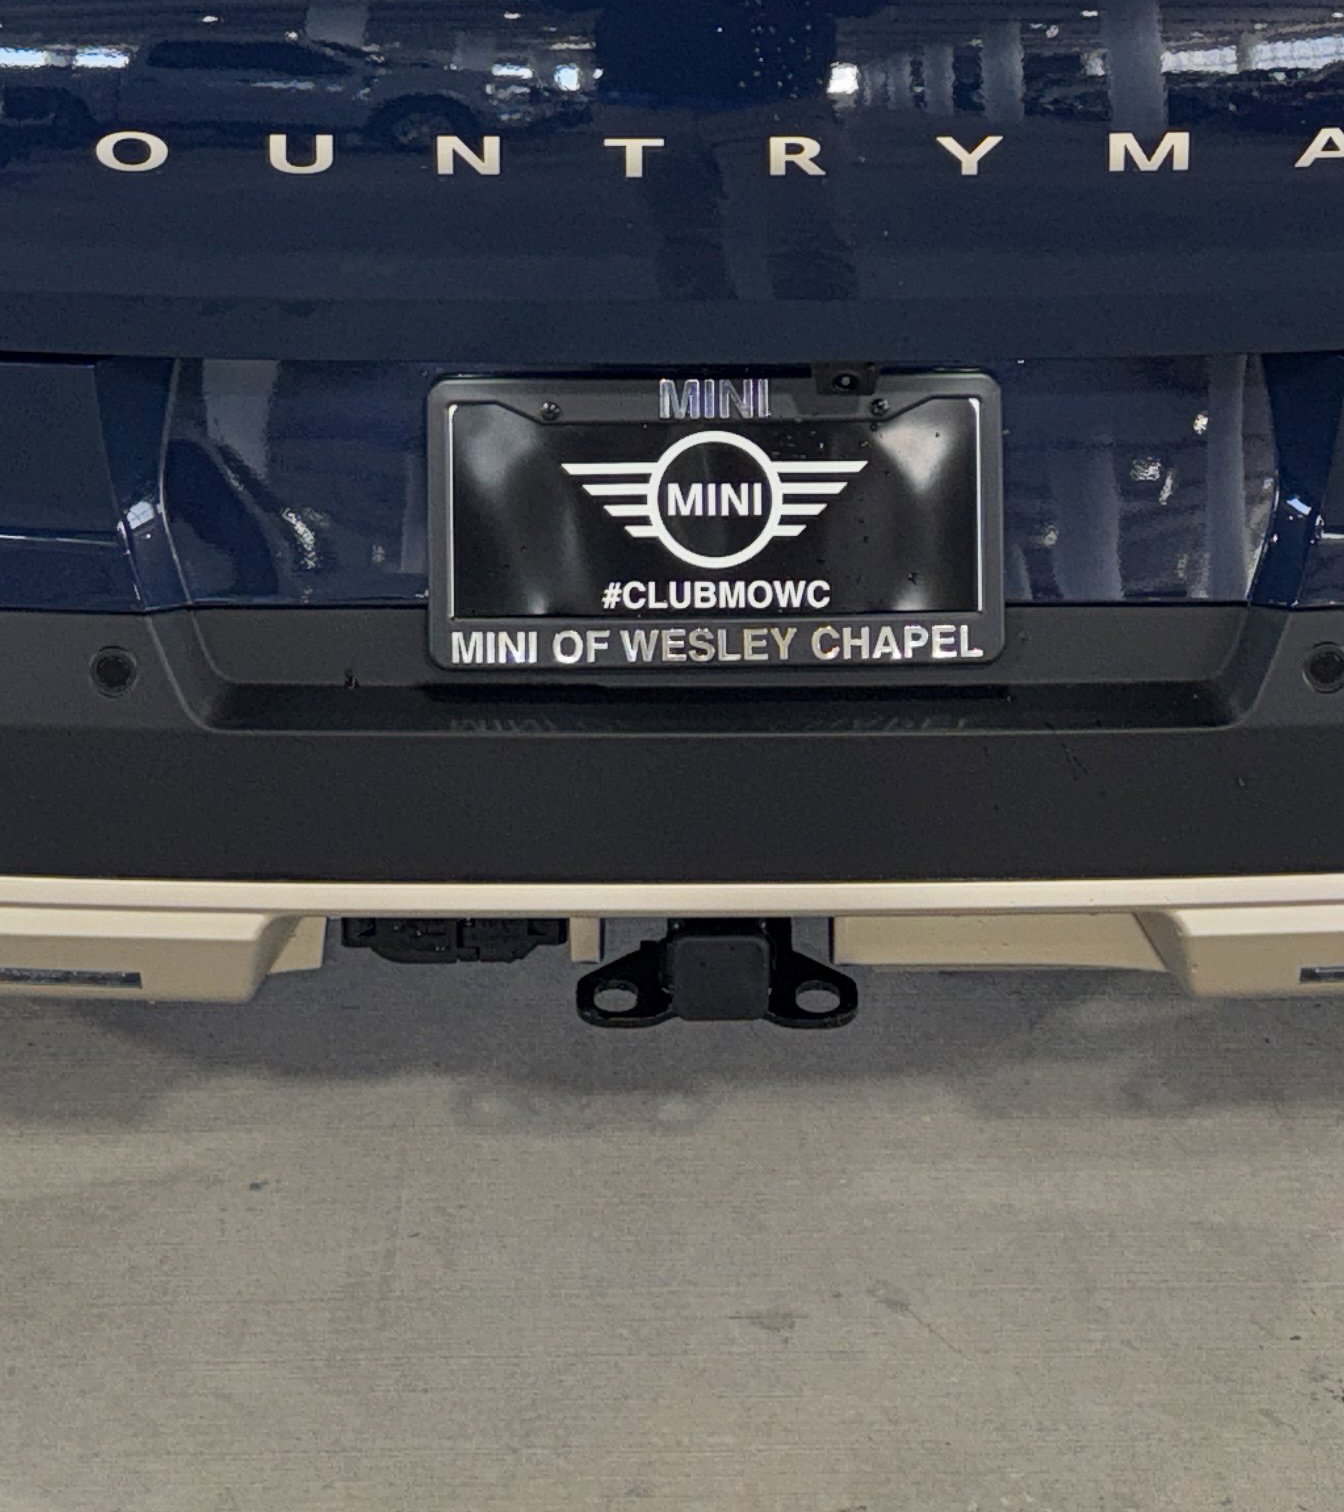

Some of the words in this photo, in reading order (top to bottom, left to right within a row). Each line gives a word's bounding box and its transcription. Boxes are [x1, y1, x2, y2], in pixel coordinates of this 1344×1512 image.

[658, 378, 773, 420] MINI
[666, 482, 763, 517] MINI
[600, 580, 831, 610] #CLUBMOWC
[450, 630, 539, 665] MINI
[551, 629, 611, 665] OF
[618, 627, 798, 663] WESLEY
[810, 624, 985, 661] CHAPEL
